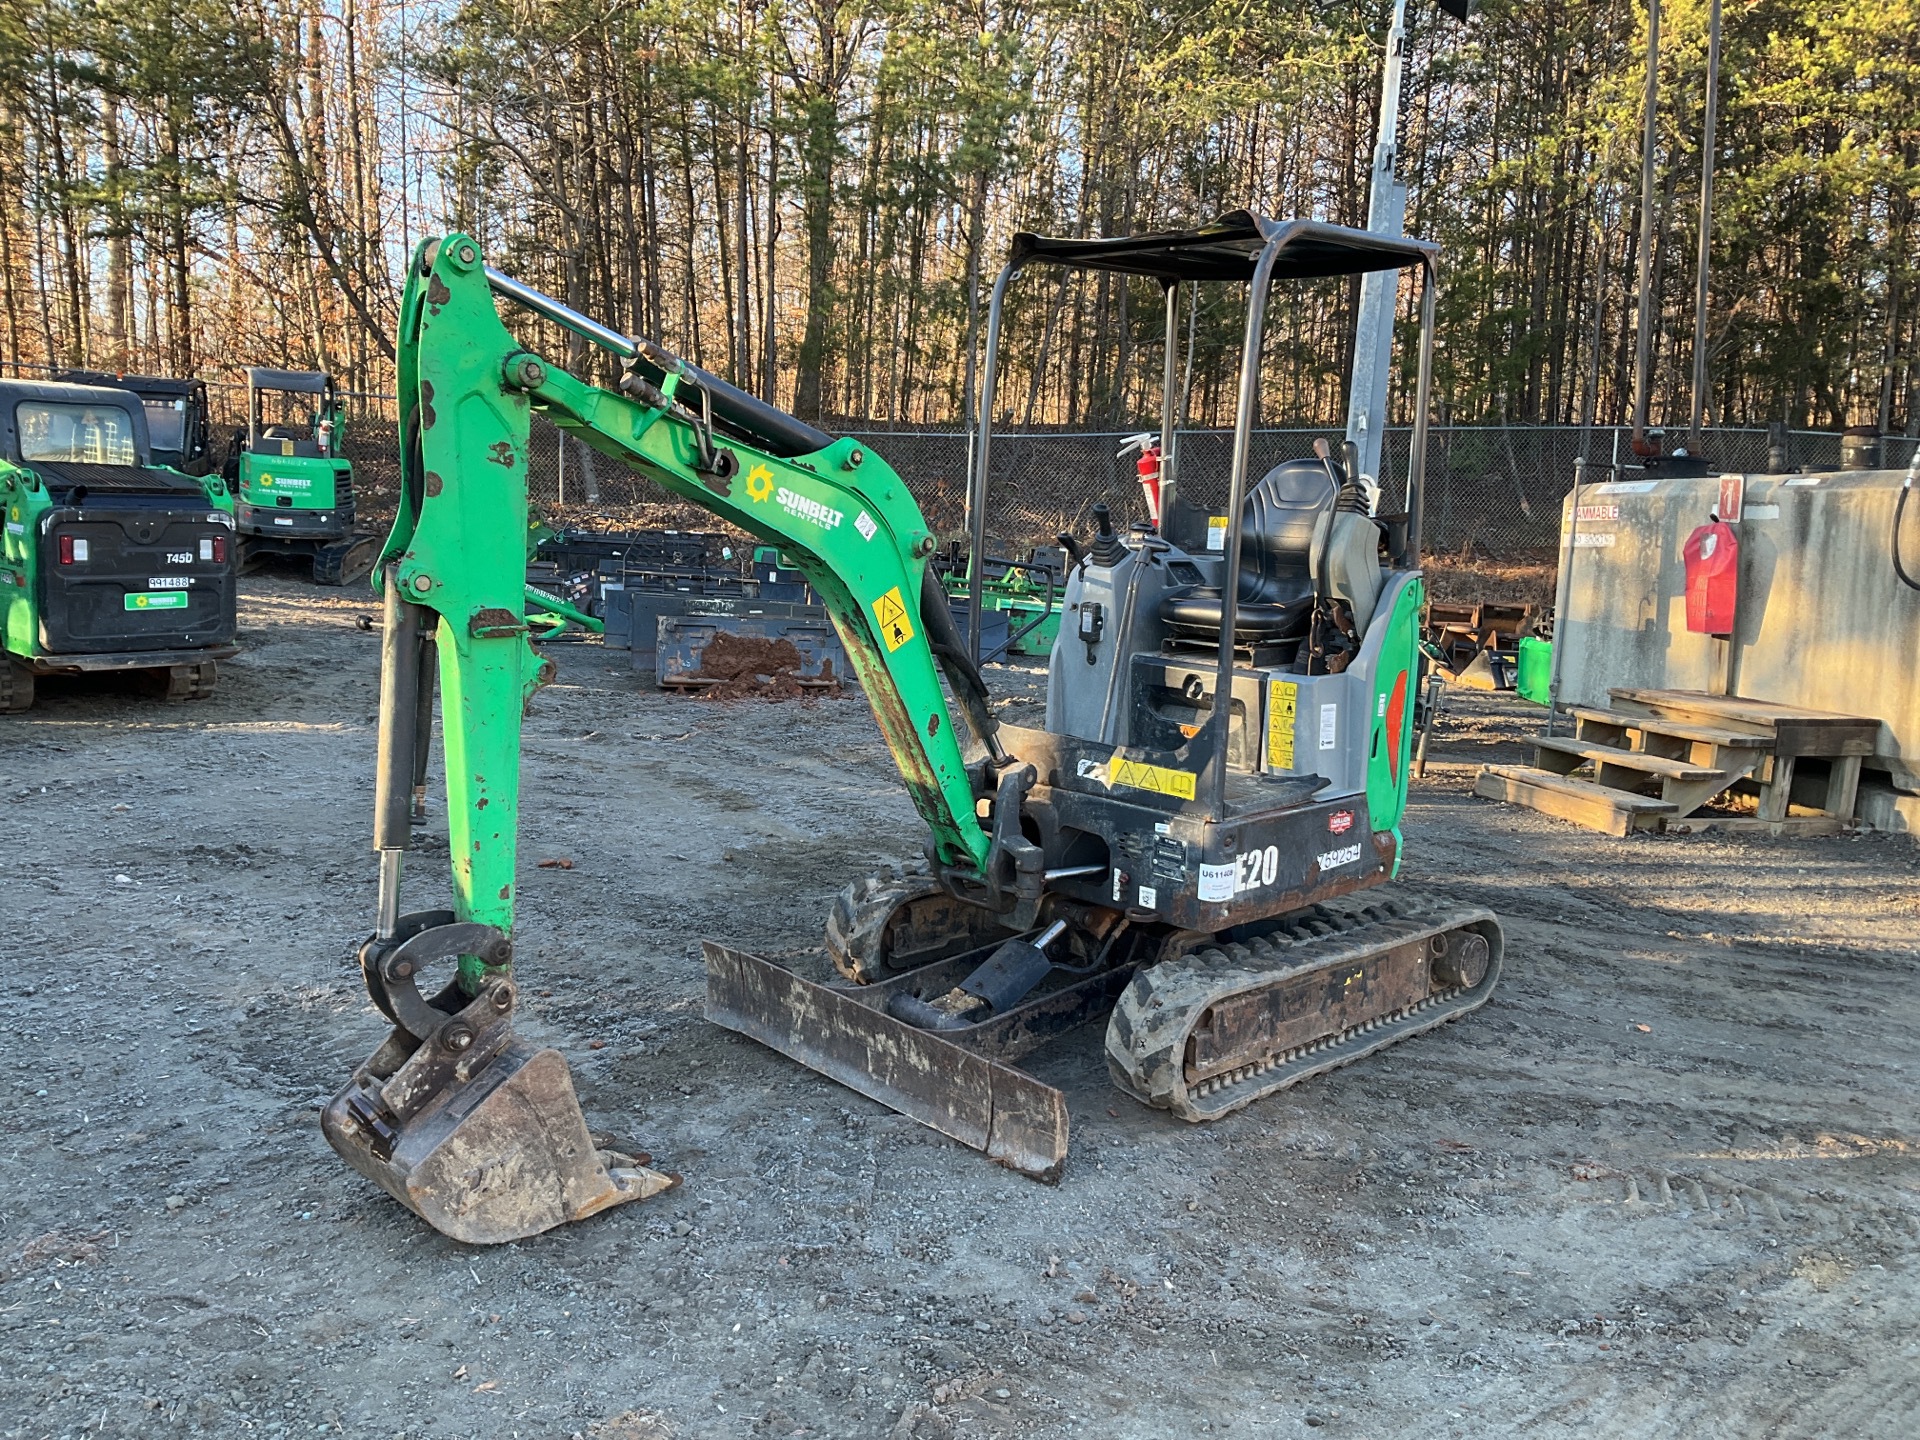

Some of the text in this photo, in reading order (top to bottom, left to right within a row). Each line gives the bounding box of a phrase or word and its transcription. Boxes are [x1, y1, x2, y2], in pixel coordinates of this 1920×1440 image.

[275, 477, 312, 487] SUNBELT
[776, 486, 844, 528] SUNBELT
[783, 505, 832, 531] RENTALS
[1567, 505, 1618, 519] FAMMABLE
[149, 578, 188, 587] 991488
[1234, 845, 1279, 893] E20
[1318, 845, 1360, 869] 759254
